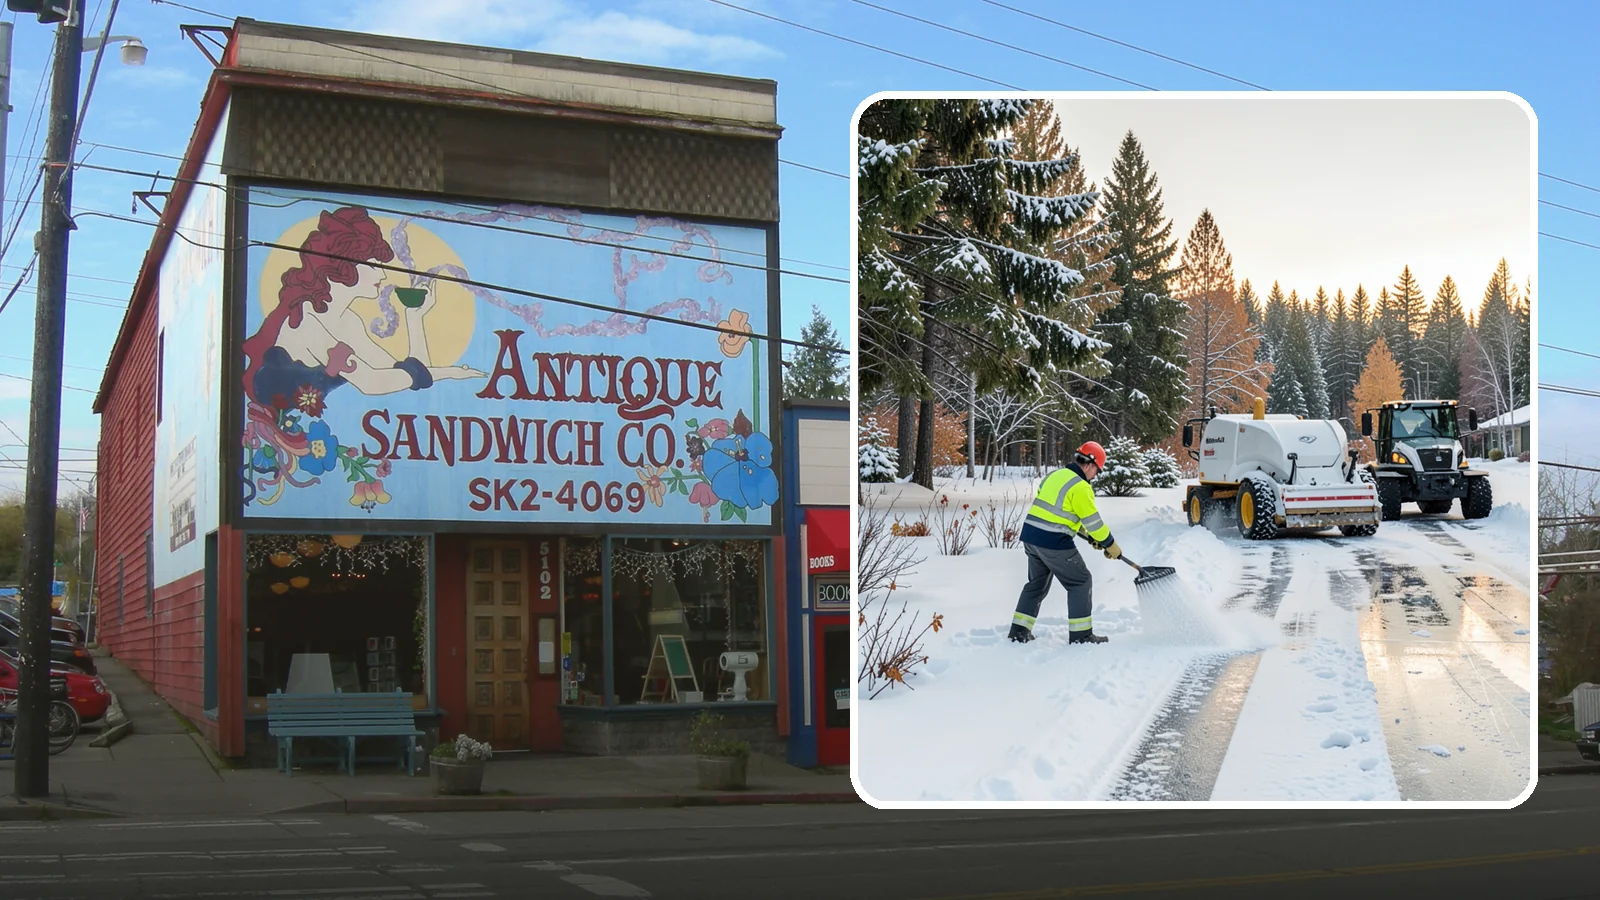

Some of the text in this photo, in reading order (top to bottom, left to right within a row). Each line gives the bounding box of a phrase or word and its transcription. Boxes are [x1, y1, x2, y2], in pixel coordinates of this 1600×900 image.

[476, 329, 723, 420] ANTIQUE
[361, 408, 685, 469] SANDWICH CO.
[468, 477, 647, 512] SK2-4069
[540, 541, 552, 600] 5102
[809, 555, 835, 569] BOOKS
